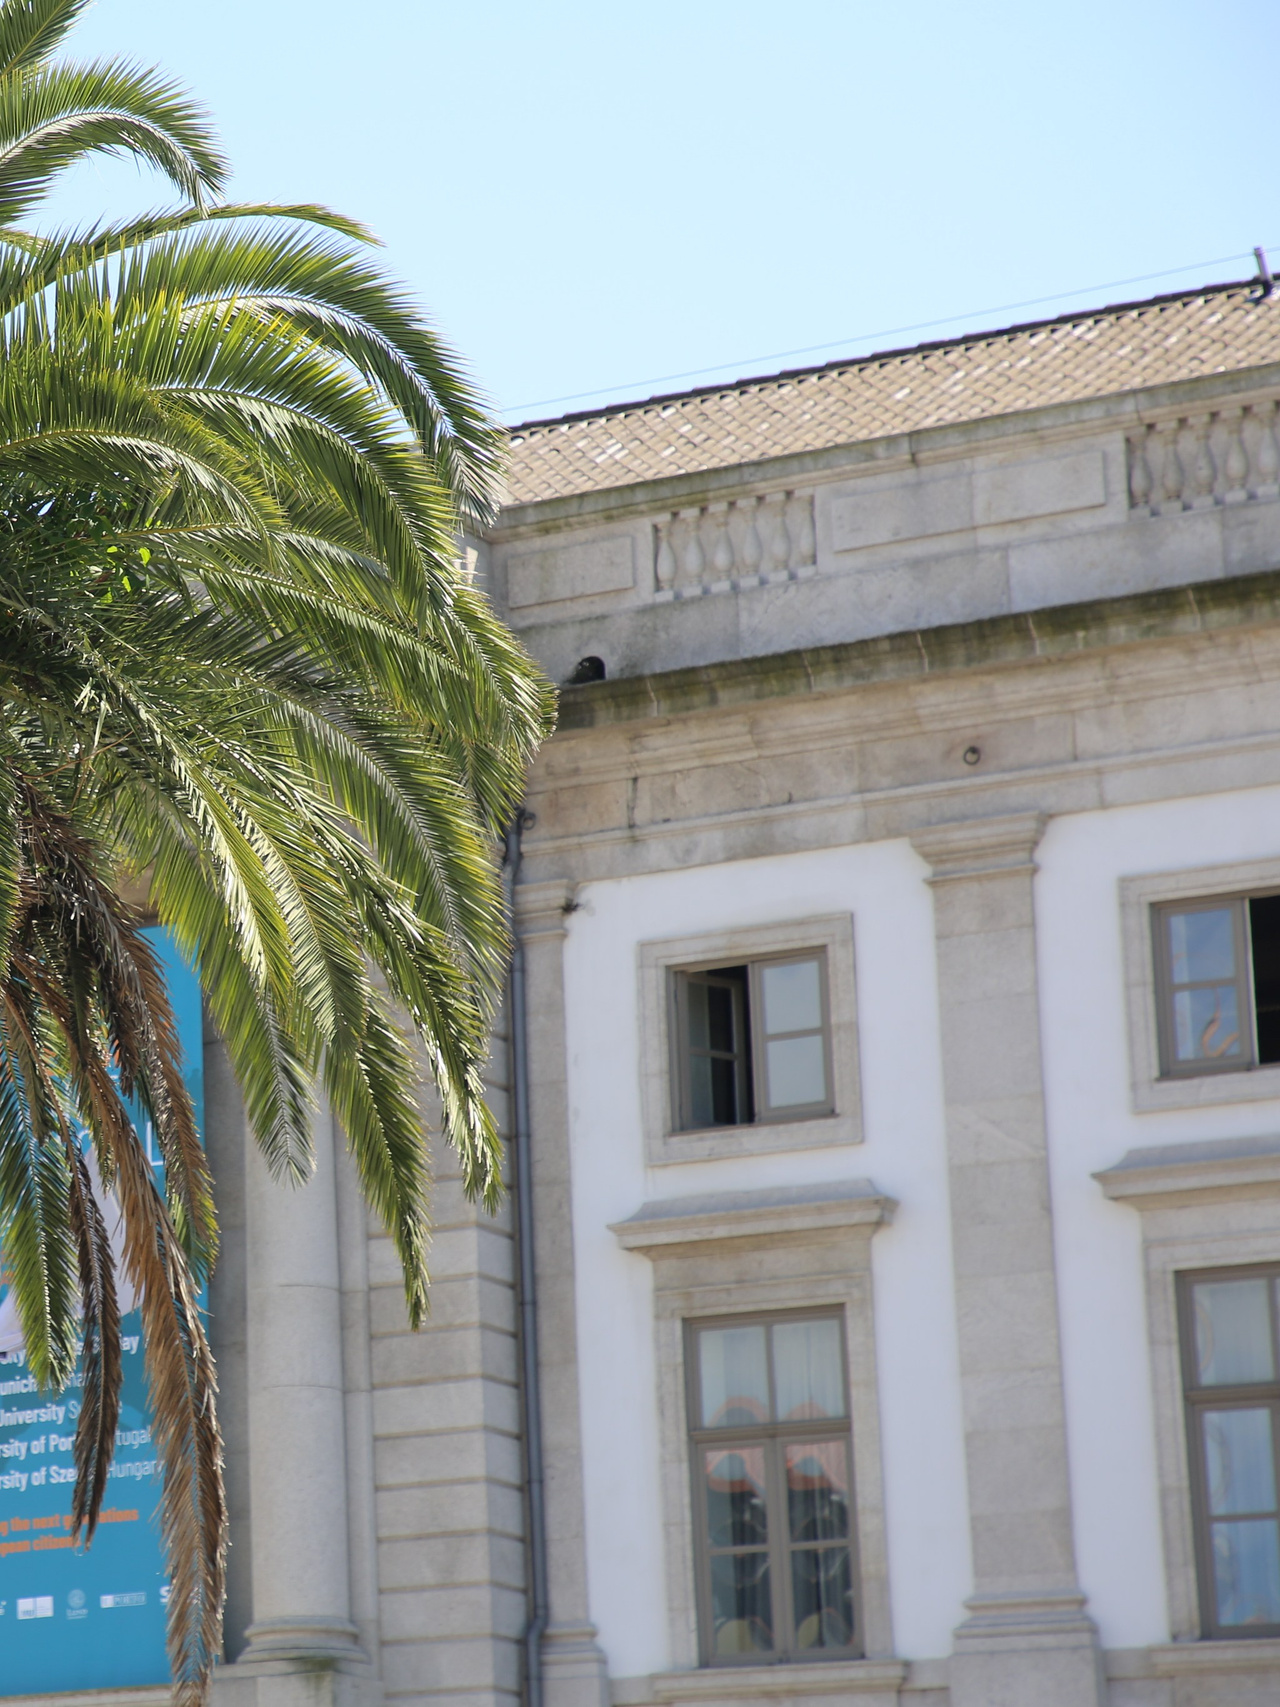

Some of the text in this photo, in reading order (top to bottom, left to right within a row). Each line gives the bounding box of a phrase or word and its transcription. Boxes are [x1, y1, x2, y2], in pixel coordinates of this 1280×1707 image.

[30, 1435, 47, 1454] of
[30, 1466, 47, 1486] of
[10, 1516, 30, 1532] the
[32, 1513, 61, 1530] next
